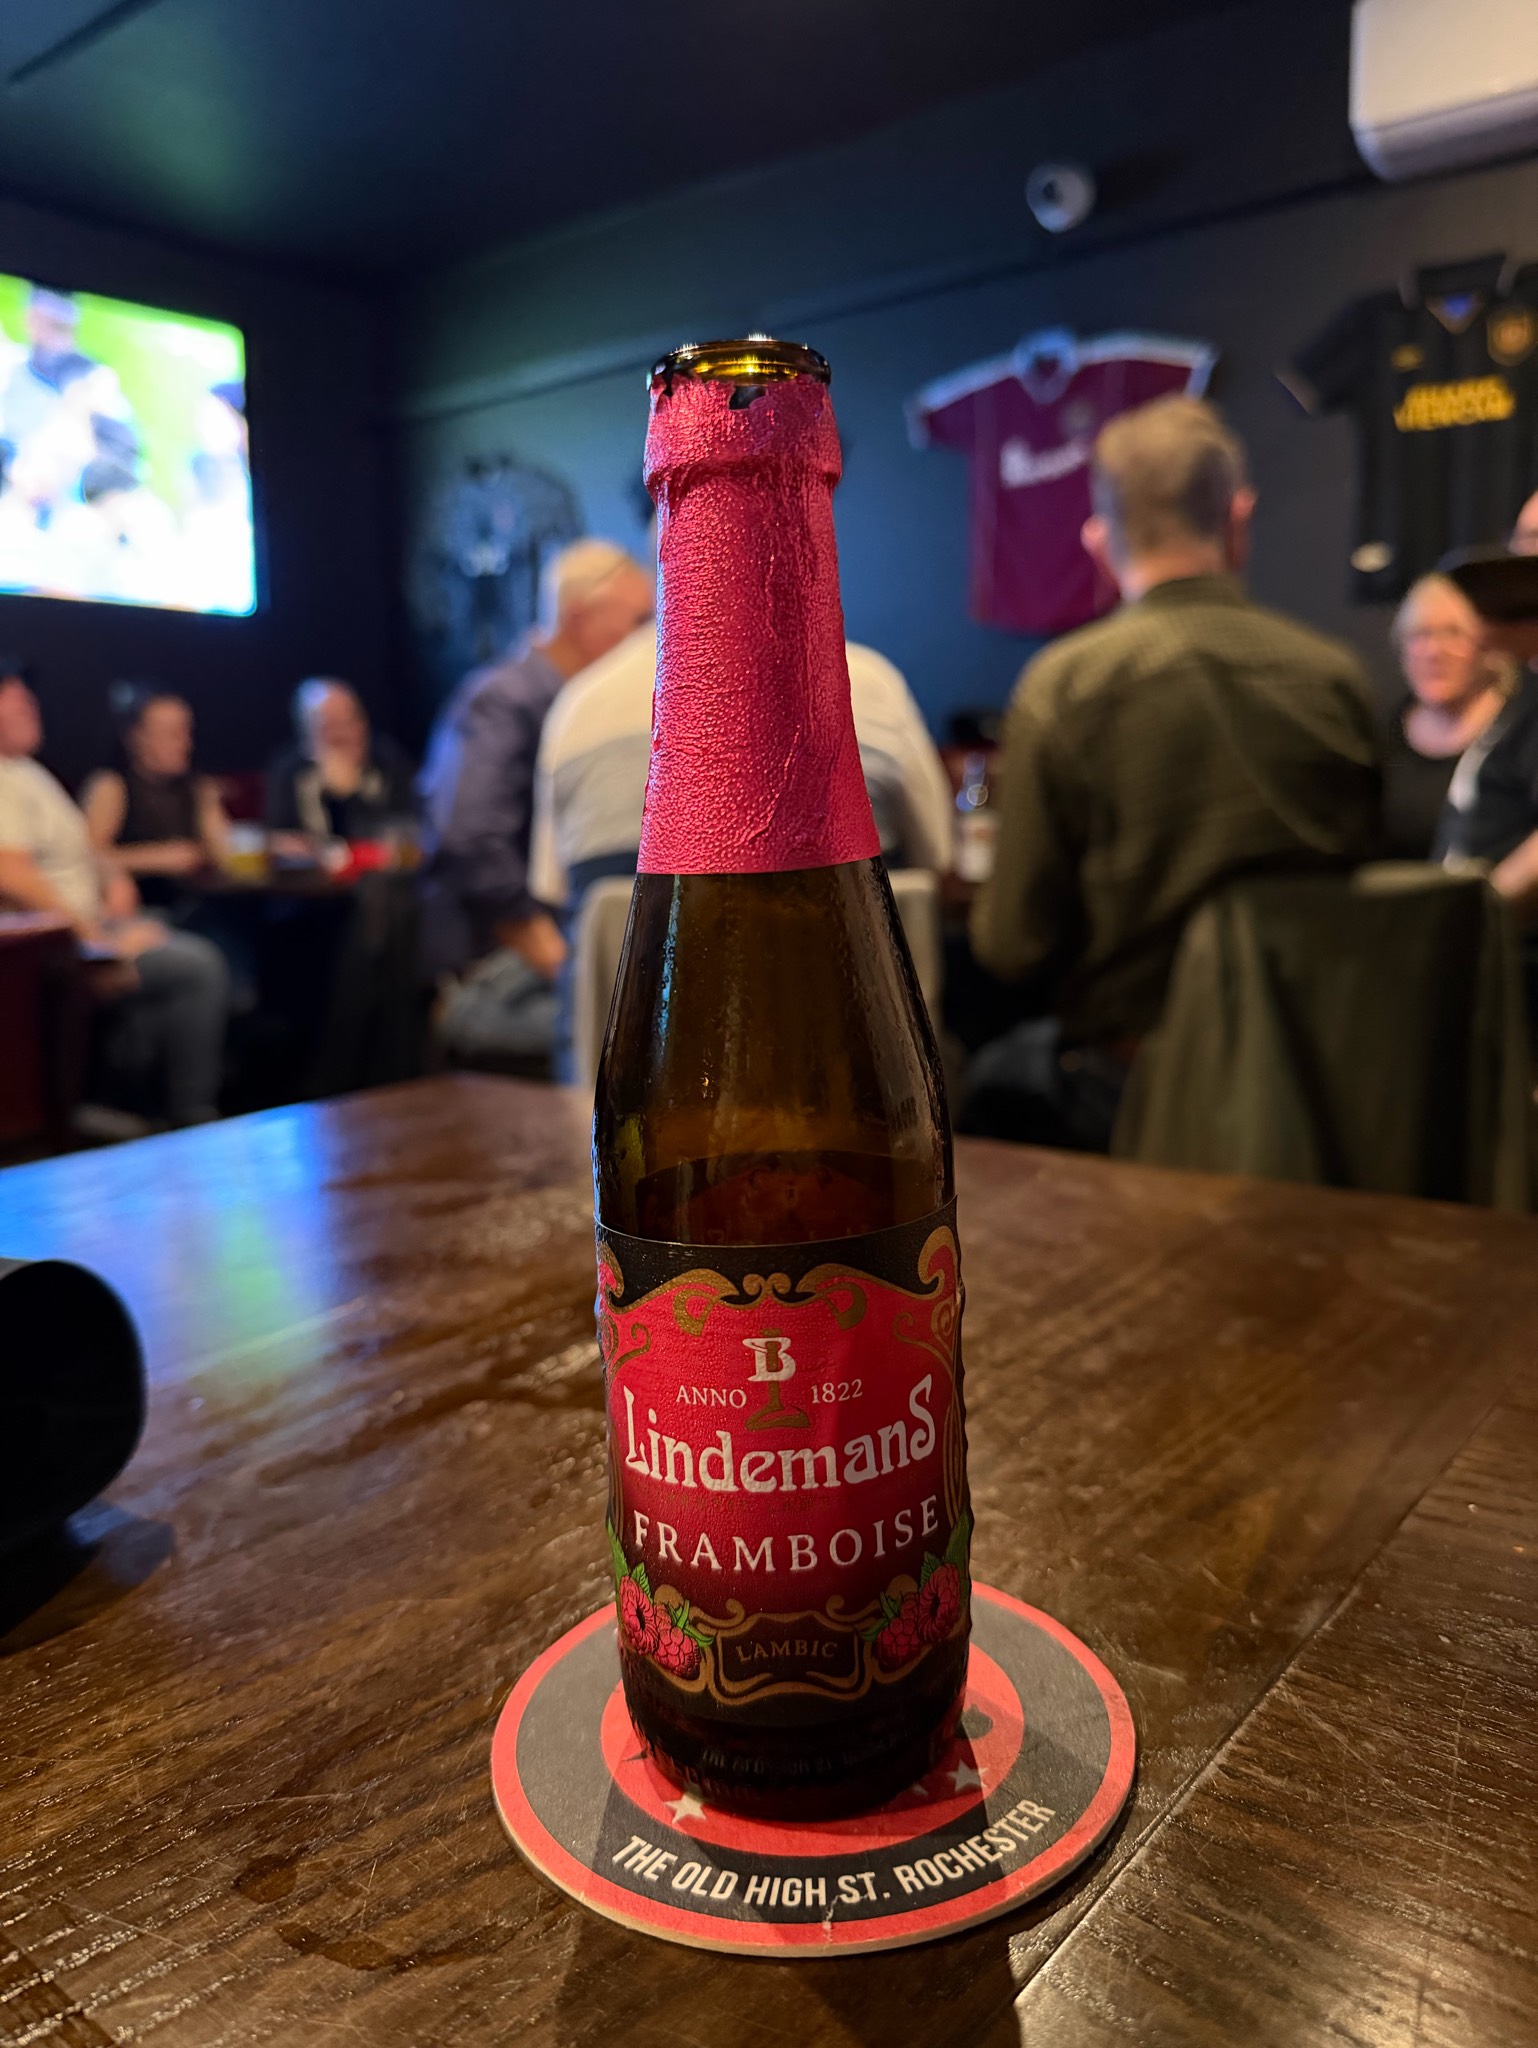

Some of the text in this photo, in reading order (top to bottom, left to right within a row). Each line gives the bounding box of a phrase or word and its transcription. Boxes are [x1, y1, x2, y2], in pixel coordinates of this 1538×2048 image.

[676, 1379, 863, 1408] ANNO 1822
[633, 1494, 940, 1573] FRAMBOISE
[735, 1638, 839, 1663] LAMBIC
[611, 1798, 1057, 1907] THE OLD HIGH ST. ROCHESTER
